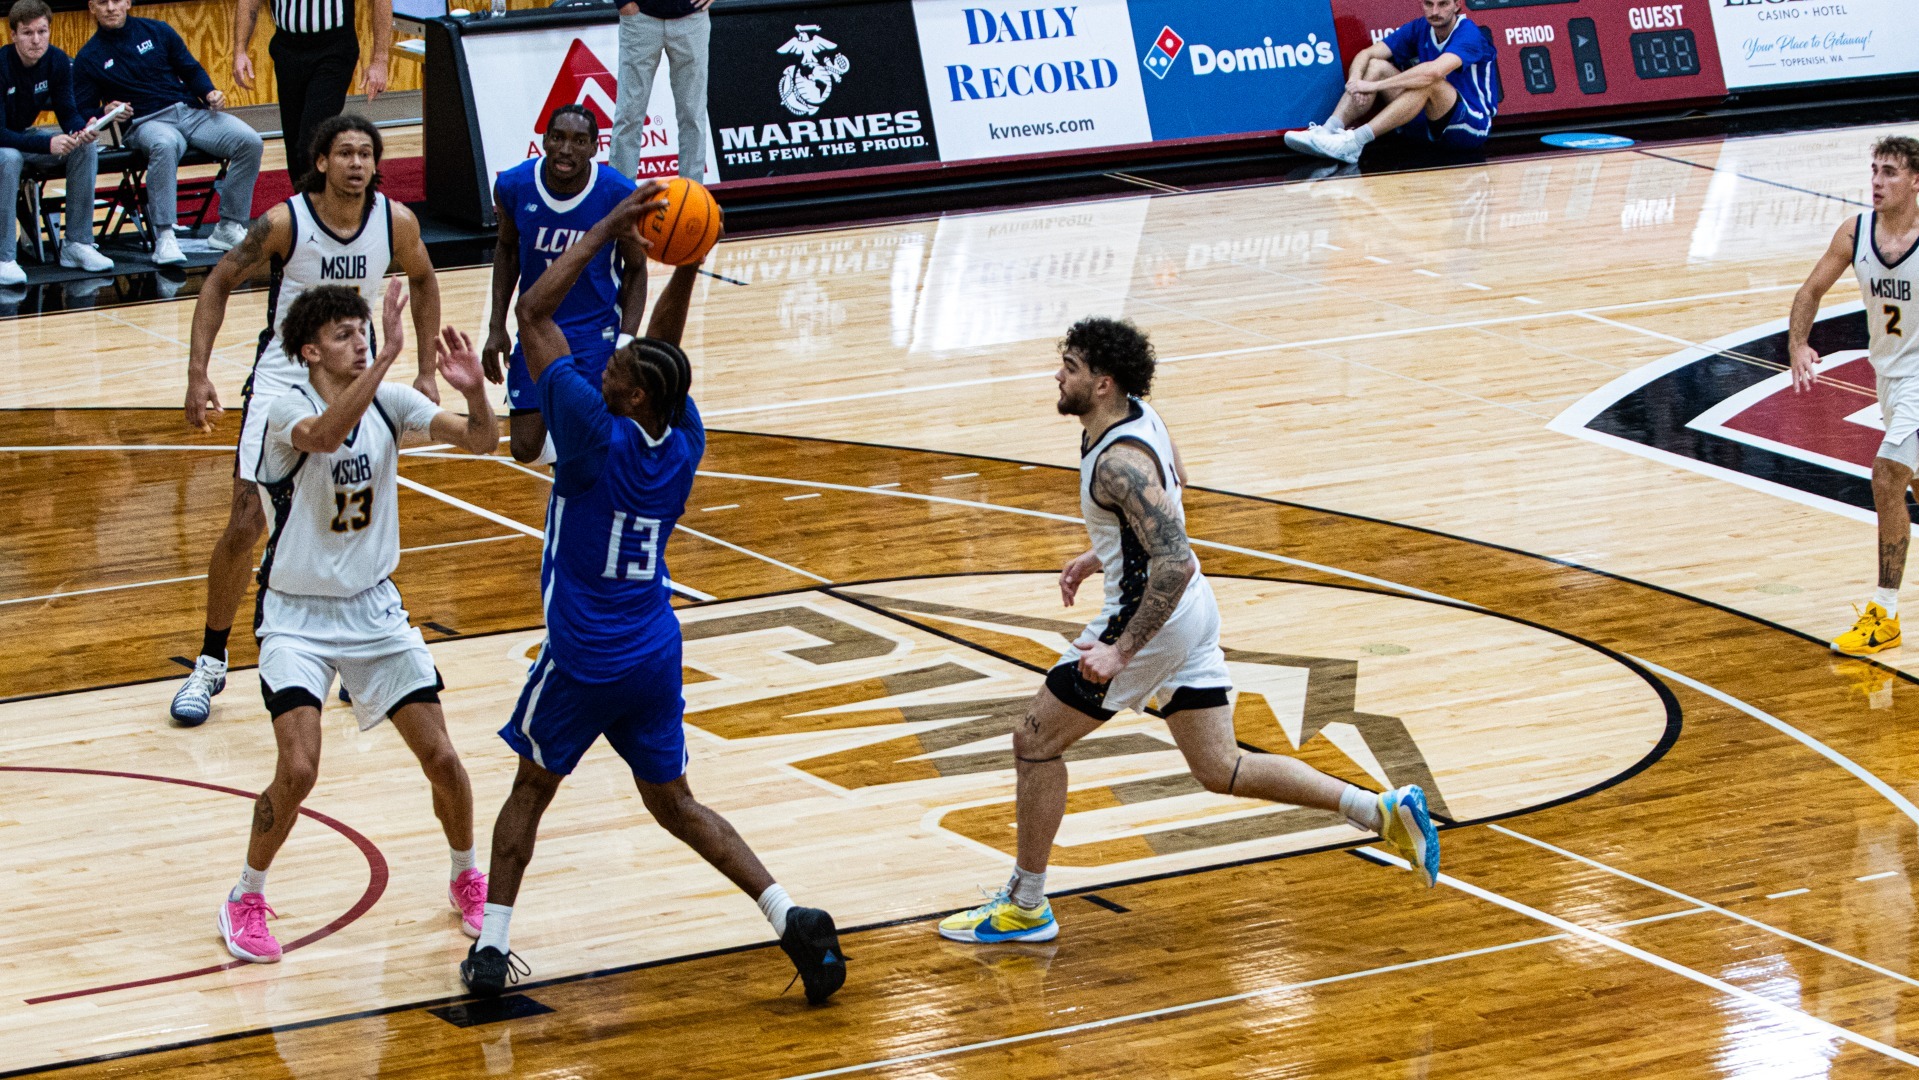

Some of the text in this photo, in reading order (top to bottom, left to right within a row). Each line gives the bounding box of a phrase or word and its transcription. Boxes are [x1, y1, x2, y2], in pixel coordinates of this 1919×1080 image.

[1628, 5, 1683, 30] GUEST
[1757, 5, 1848, 21] CASINO HOTEL
[136, 39, 153, 53] LCU
[1505, 25, 1555, 45] PERIOD
[1742, 30, 1873, 61] Your Place to Getaway!
[1189, 33, 1334, 75] Domino's
[1829, 55, 1844, 63] WA
[720, 110, 922, 151] MARINES
[989, 118, 1095, 140] kvnews.com
[724, 135, 929, 166] THE FEW. THE PROUD.
[321, 255, 367, 279] MSUB
[1870, 277, 1911, 301] MSUB
[1883, 304, 1902, 337] 2
[330, 453, 372, 485] MSUB
[601, 510, 661, 580] 13
